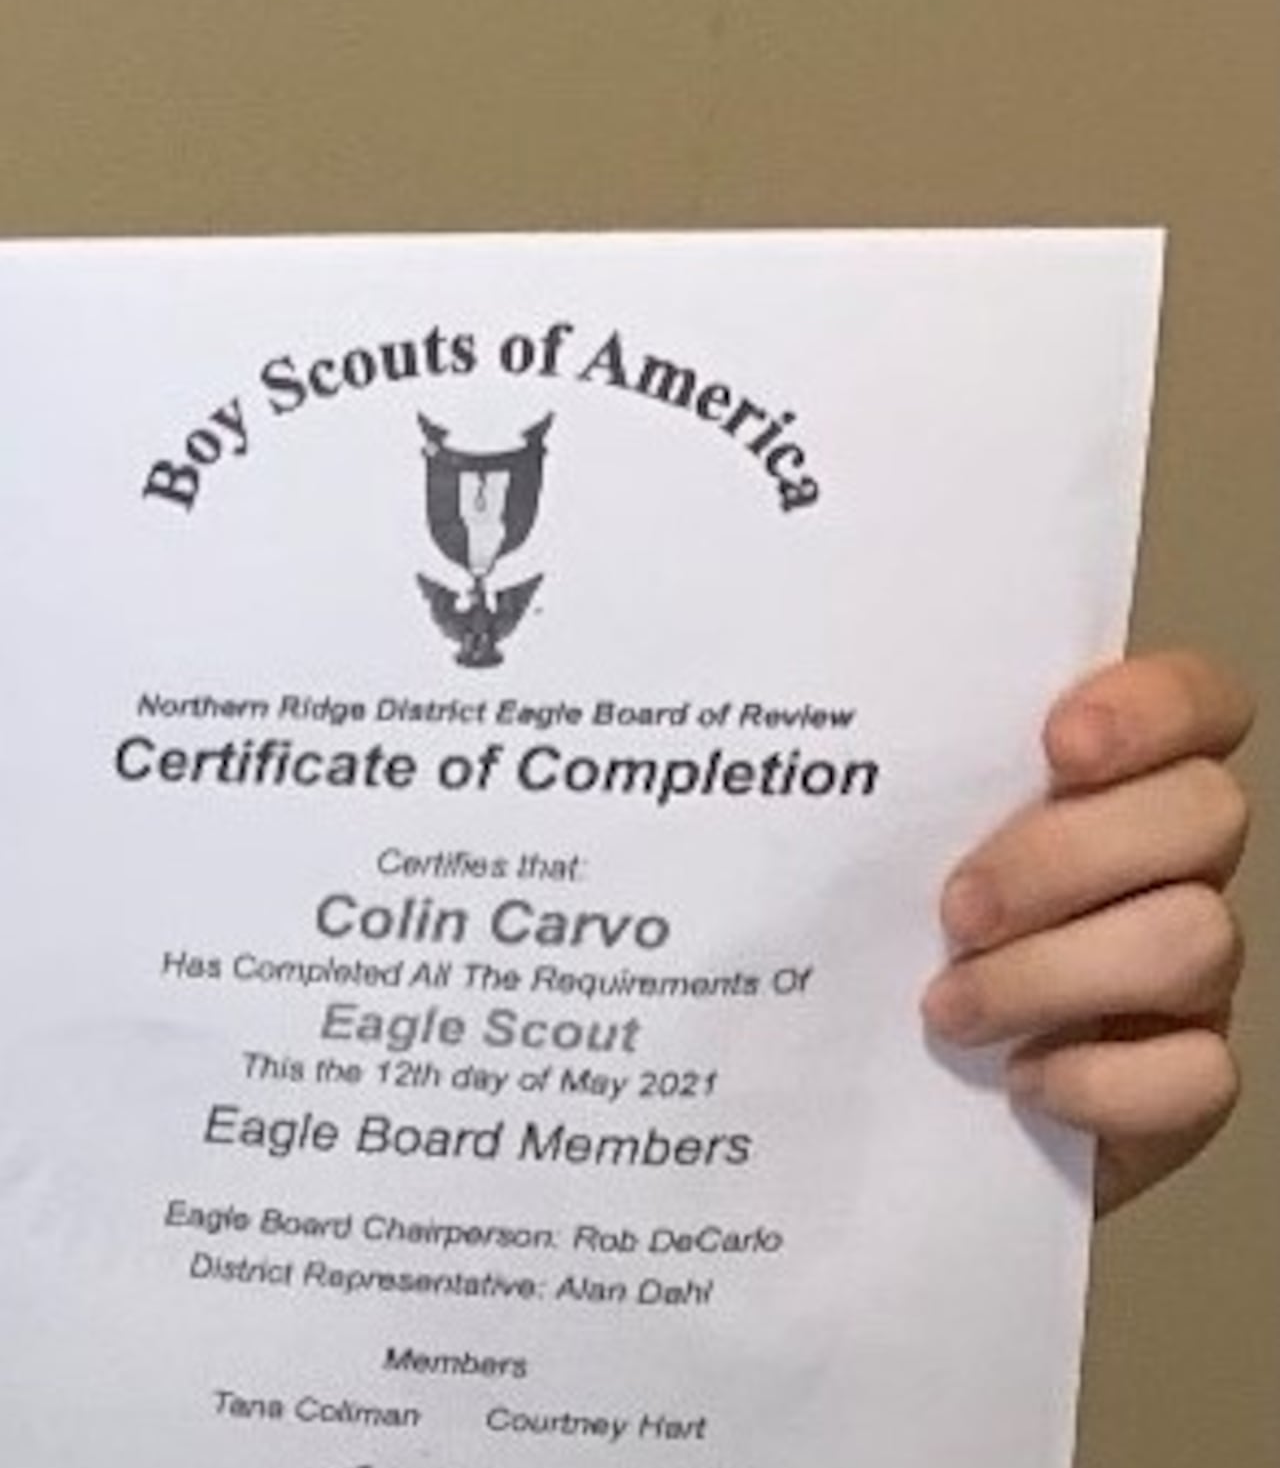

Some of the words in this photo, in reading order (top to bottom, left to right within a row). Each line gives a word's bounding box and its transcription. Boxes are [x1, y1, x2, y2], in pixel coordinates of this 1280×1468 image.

[141, 397, 248, 512] Boy
[260, 325, 478, 416] Scouts
[499, 322, 575, 377] of
[576, 330, 820, 514] America
[136, 692, 270, 719] Northern
[277, 694, 367, 727] Ridge
[374, 696, 488, 725] District
[494, 698, 584, 731] Eagle
[591, 700, 692, 727] Board
[695, 701, 733, 729] of
[738, 702, 856, 730] Review
[114, 735, 418, 790] Certificate
[438, 742, 505, 791] of
[517, 744, 880, 807] Completion
[376, 846, 509, 879] Certifies
[316, 893, 469, 944] Colin
[490, 898, 671, 951] Carvo
[161, 950, 222, 980] Has
[232, 952, 405, 988] Completed
[407, 960, 453, 988] All
[464, 961, 523, 992] The
[529, 964, 761, 1001] Requirements
[770, 965, 814, 996] Of
[319, 1001, 467, 1054] Eagle
[482, 1007, 641, 1055] Scout
[242, 1051, 305, 1083] This
[315, 1056, 364, 1085] the
[377, 1059, 443, 1088] 12th
[450, 1064, 510, 1097] day
[516, 1064, 554, 1093] of
[559, 1067, 629, 1104] May
[637, 1069, 718, 1099] 2021
[203, 1103, 340, 1159] Eagle
[355, 1114, 505, 1161] Board
[517, 1120, 753, 1167] Members
[163, 1198, 252, 1236] Eagle
[258, 1207, 354, 1241] Board
[572, 1224, 640, 1254] Rob
[189, 1250, 295, 1287] District
[554, 1274, 628, 1304] Alan
[382, 1346, 528, 1380] Members
[485, 1405, 630, 1444] Courtney
[638, 1413, 708, 1441] Hart
